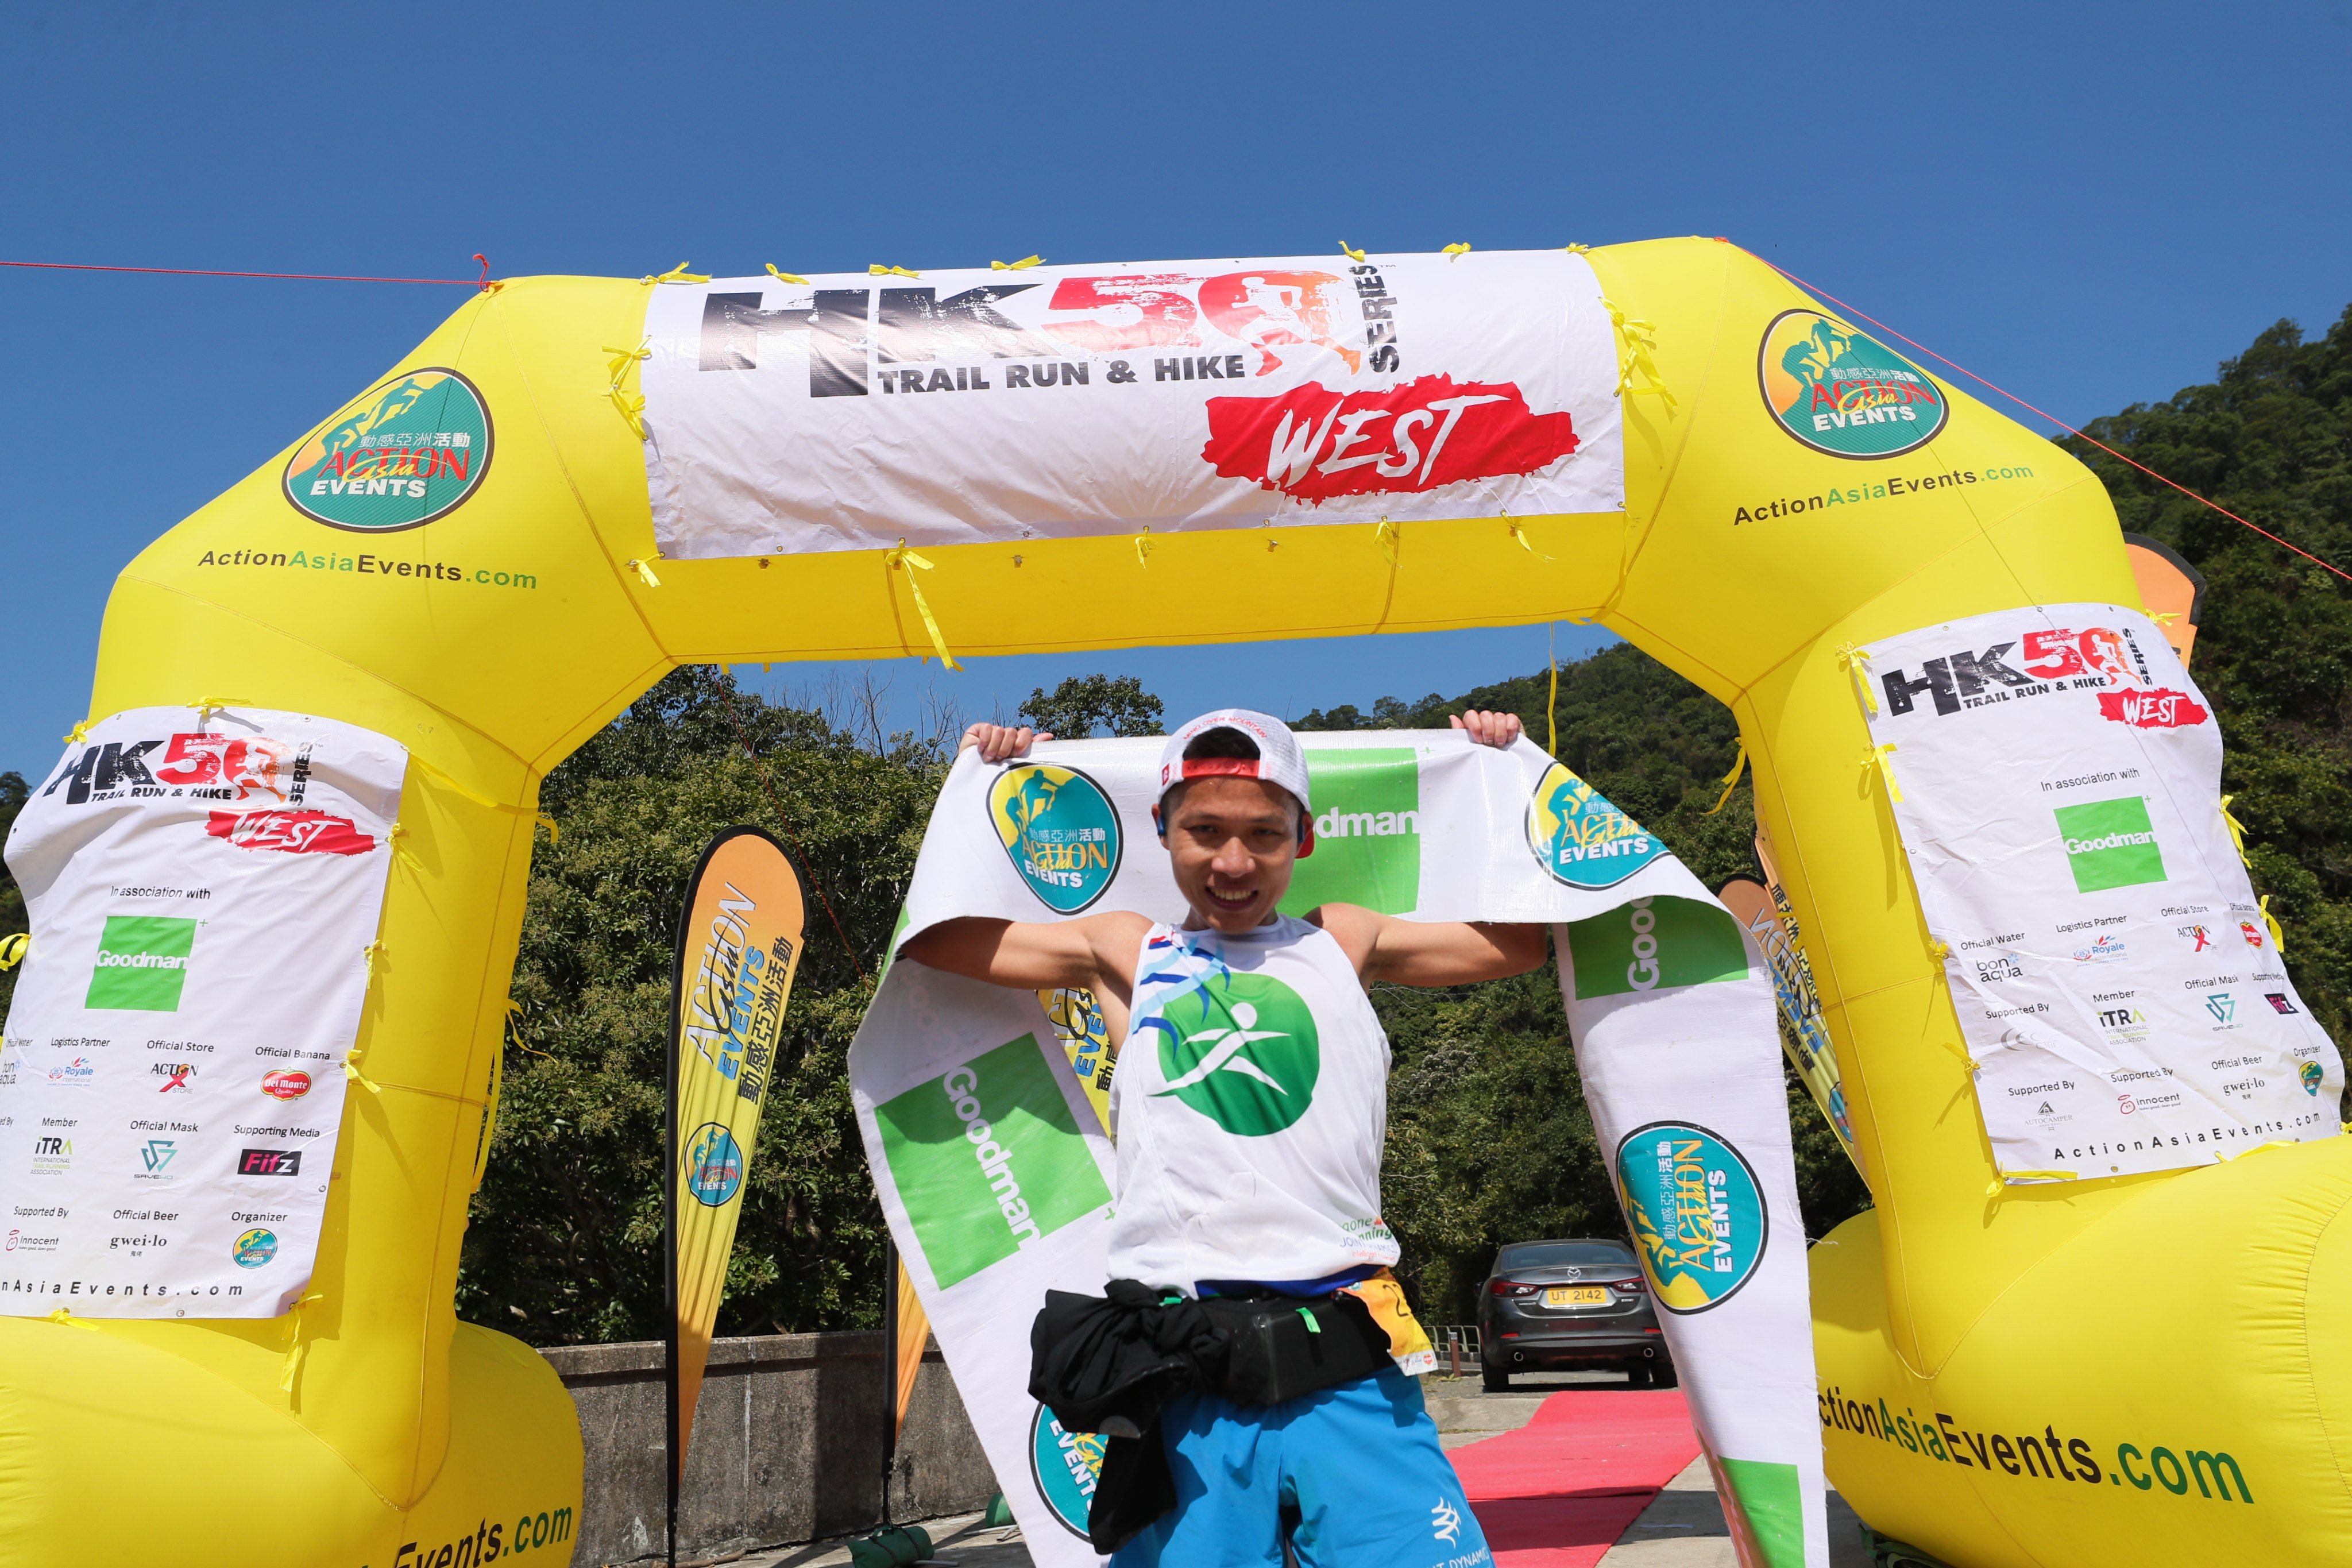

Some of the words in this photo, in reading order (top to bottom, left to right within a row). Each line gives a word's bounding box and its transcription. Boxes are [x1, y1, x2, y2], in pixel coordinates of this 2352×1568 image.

[1348, 265, 1400, 373] SERIES
[878, 366, 990, 395] TRAIL
[1006, 361, 1089, 389] RUN
[1106, 359, 1139, 384] &
[1154, 354, 1246, 382] HIKE
[1830, 367, 1920, 383] 動感亞洲活動
[1810, 379, 1937, 412] ACTION
[1812, 405, 1917, 432] EVENTS
[358, 432, 470, 448] 動感亞洲活動
[1266, 394, 1512, 488] WEST
[317, 447, 470, 481] ACTION
[310, 478, 427, 499] EVENTS
[1733, 465, 2035, 526] ActionAsiaEvents.com
[197, 550, 538, 589] ActionAsiaEvents.com
[2122, 627, 2153, 686] SERIES
[1963, 692, 2011, 709] TRAIL
[2015, 682, 2050, 697] RUN
[2055, 680, 2069, 692] &
[2072, 677, 2107, 689] HIKE
[2122, 694, 2186, 725] WEST
[1203, 717, 1226, 725] OVER
[1228, 717, 1268, 739] MOUNTAIN
[289, 741, 314, 806] SERIES
[2040, 781, 2050, 792] In
[2056, 772, 2117, 790] association
[2118, 767, 2141, 781] with
[91, 789, 126, 802] TRAIL
[130, 787, 167, 798] RUN
[171, 787, 183, 798] &
[190, 787, 233, 800] HIKE
[1312, 806, 1420, 839] dman
[231, 810, 349, 852] WEST
[1029, 827, 1106, 843] 動感亞洲活動
[2065, 830, 2157, 855] Goodman
[1022, 835, 1108, 870] ACTION
[1559, 837, 1650, 865] EVENTS
[1024, 859, 1083, 889] EVENTS
[110, 885, 119, 898] In
[119, 886, 183, 899] association
[186, 887, 211, 900] with
[2161, 906, 2190, 917] Official
[2191, 905, 2210, 914] Store
[2056, 920, 2093, 934] Logistics
[2093, 914, 2128, 928] Partner
[1960, 937, 1995, 951] Official
[1995, 932, 2025, 944] Water
[2092, 943, 2125, 954] Royale
[95, 950, 188, 970] Goodman
[1976, 958, 2009, 972] bon
[686, 882, 756, 1066] ACTION
[1980, 967, 2023, 983] aqua
[2184, 976, 2217, 990] Official
[2218, 974, 2239, 984] Mask
[2092, 989, 2135, 1003] Member
[716, 945, 766, 1081] EVENTS
[1986, 1004, 2035, 1019] Supported
[2037, 1002, 2050, 1012] By
[737, 935, 794, 1107] 動感亞洲活動
[2104, 1025, 2149, 1034] INTERNATIONAL
[51, 1037, 79, 1048] Logistics
[80, 1037, 111, 1047] Partner
[146, 1040, 183, 1051] Official
[186, 1041, 214, 1052] Store
[2109, 1036, 2146, 1045] ASSOCIATION
[255, 1046, 291, 1058] Official
[293, 1049, 331, 1060] Banana
[2293, 1045, 2321, 1057] Organizer
[2, 1061, 15, 1073] bon
[2211, 1057, 2242, 1071] Official
[2242, 1056, 2262, 1066] Beer
[64, 1067, 93, 1077] Royale
[2110, 1069, 2161, 1083] Supported
[2161, 1067, 2173, 1077] By
[265, 1079, 279, 1087] Del
[280, 1080, 308, 1089] Monte
[2008, 1081, 2060, 1096] Supported
[2063, 1080, 2075, 1090] By
[2136, 1092, 2180, 1106] innocent
[42, 1117, 78, 1127] Member
[130, 1121, 167, 1131] Official
[171, 1122, 199, 1133] Mask
[2024, 1114, 2074, 1126] AUTOCAMPER
[233, 1125, 287, 1138] Supporting
[289, 1127, 320, 1138] Media
[244, 1153, 295, 1173] Fitz
[943, 1065, 1041, 1250] Goodman
[1657, 1141, 1677, 1241] 動感亞洲活動
[13, 1206, 56, 1218] Supported
[57, 1207, 69, 1219] By
[1672, 1139, 1711, 1272] ACTION
[113, 1210, 150, 1220] Official
[153, 1211, 179, 1221] Beer
[231, 1211, 288, 1223] Organizer
[1708, 1169, 1733, 1273] EVENTS
[20, 1236, 59, 1245] innocent
[1551, 1291, 1567, 1301] UT
[1573, 1289, 1602, 1300] 2142
